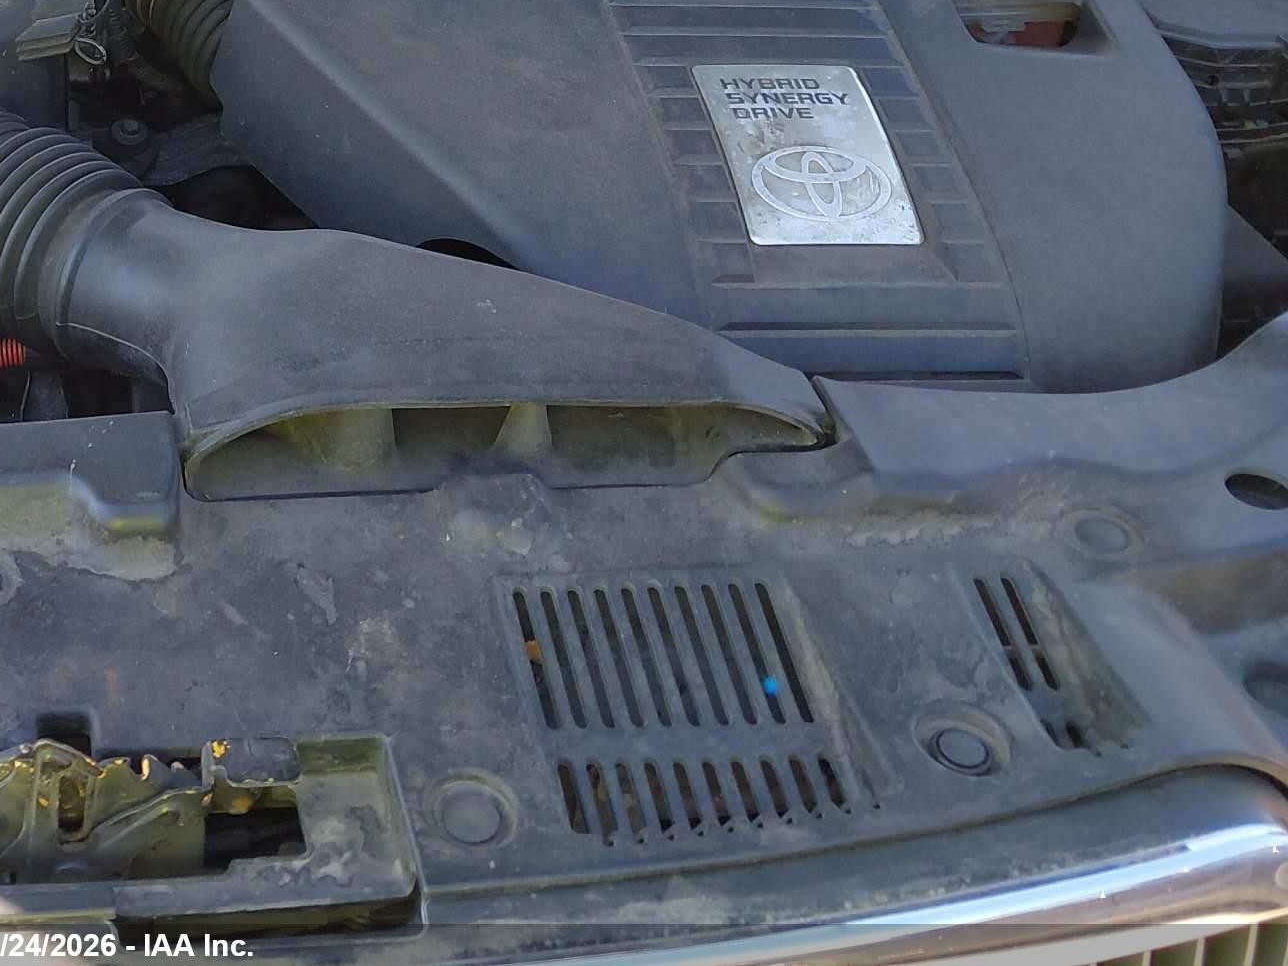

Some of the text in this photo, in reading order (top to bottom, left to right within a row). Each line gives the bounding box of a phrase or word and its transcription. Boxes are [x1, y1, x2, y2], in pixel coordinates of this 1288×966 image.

[720, 78, 820, 90] HYBRID
[725, 92, 848, 105] SYNERGY
[732, 107, 815, 119] DRIVE
